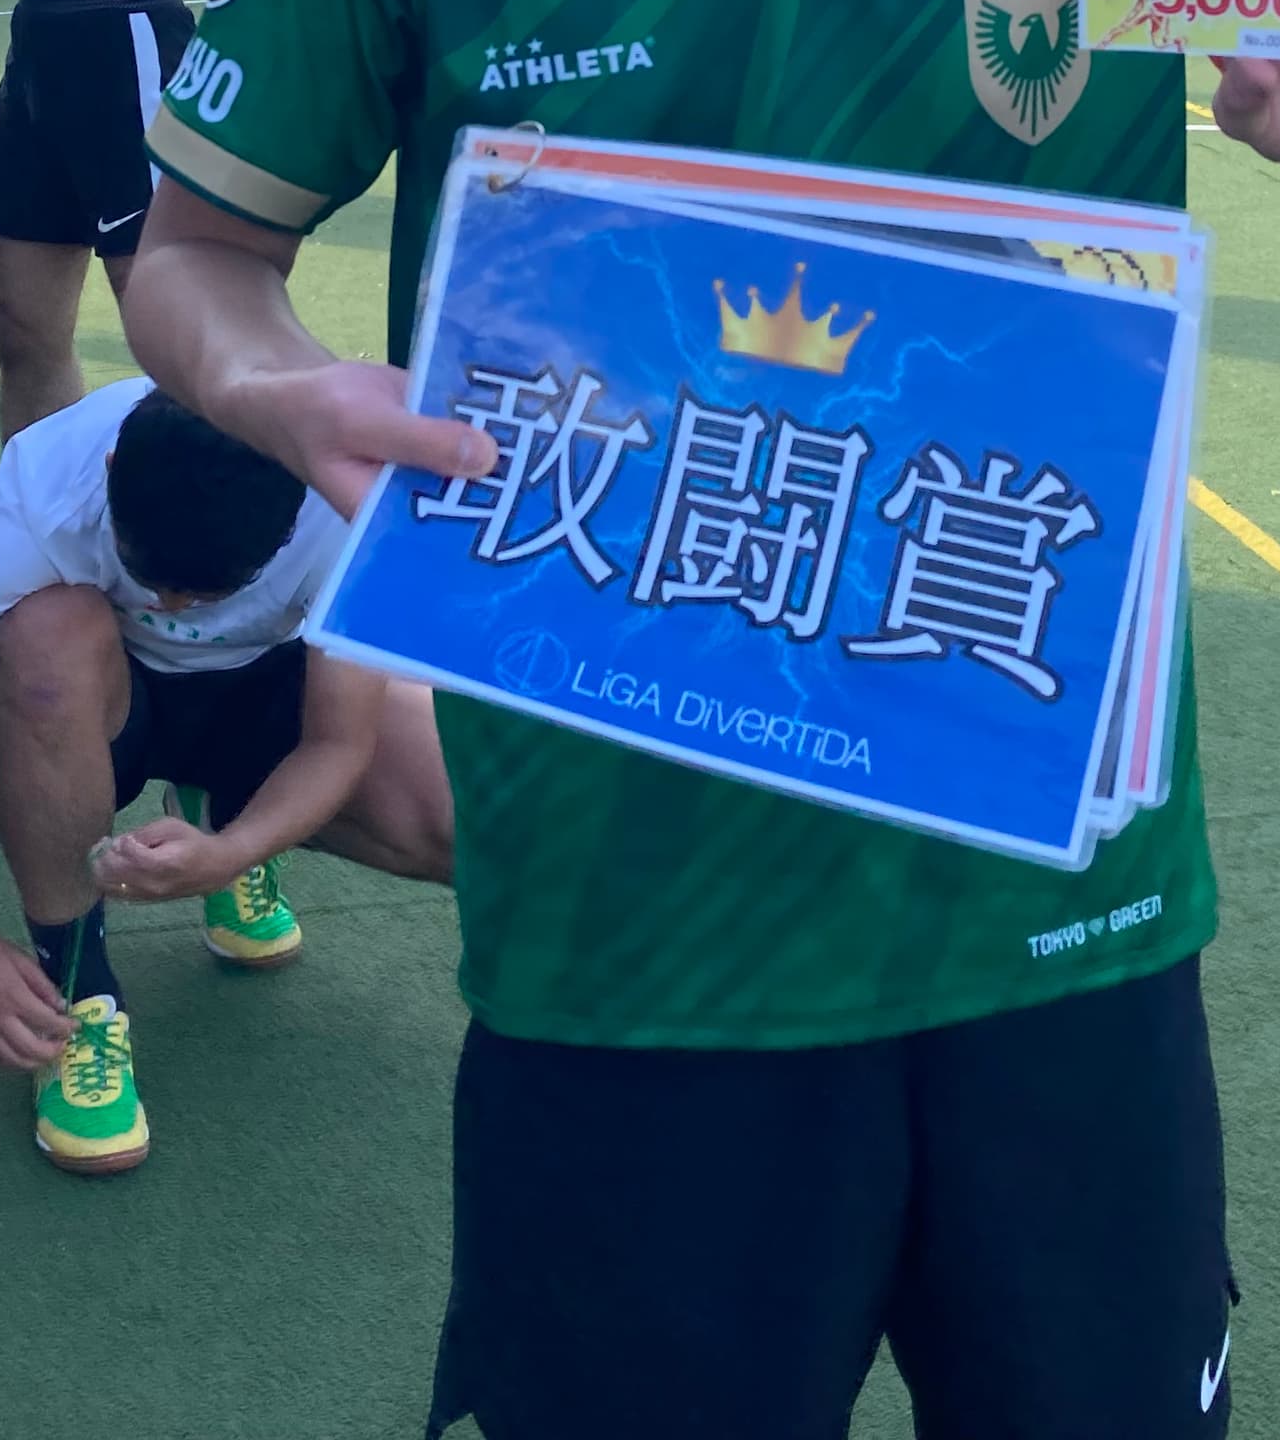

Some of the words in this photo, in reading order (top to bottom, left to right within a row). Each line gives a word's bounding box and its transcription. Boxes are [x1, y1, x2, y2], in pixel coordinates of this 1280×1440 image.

[480, 41, 654, 92] ATHLETA
[410, 366, 1101, 701] 敢闘賞
[1027, 921, 1087, 959] TOKYO
